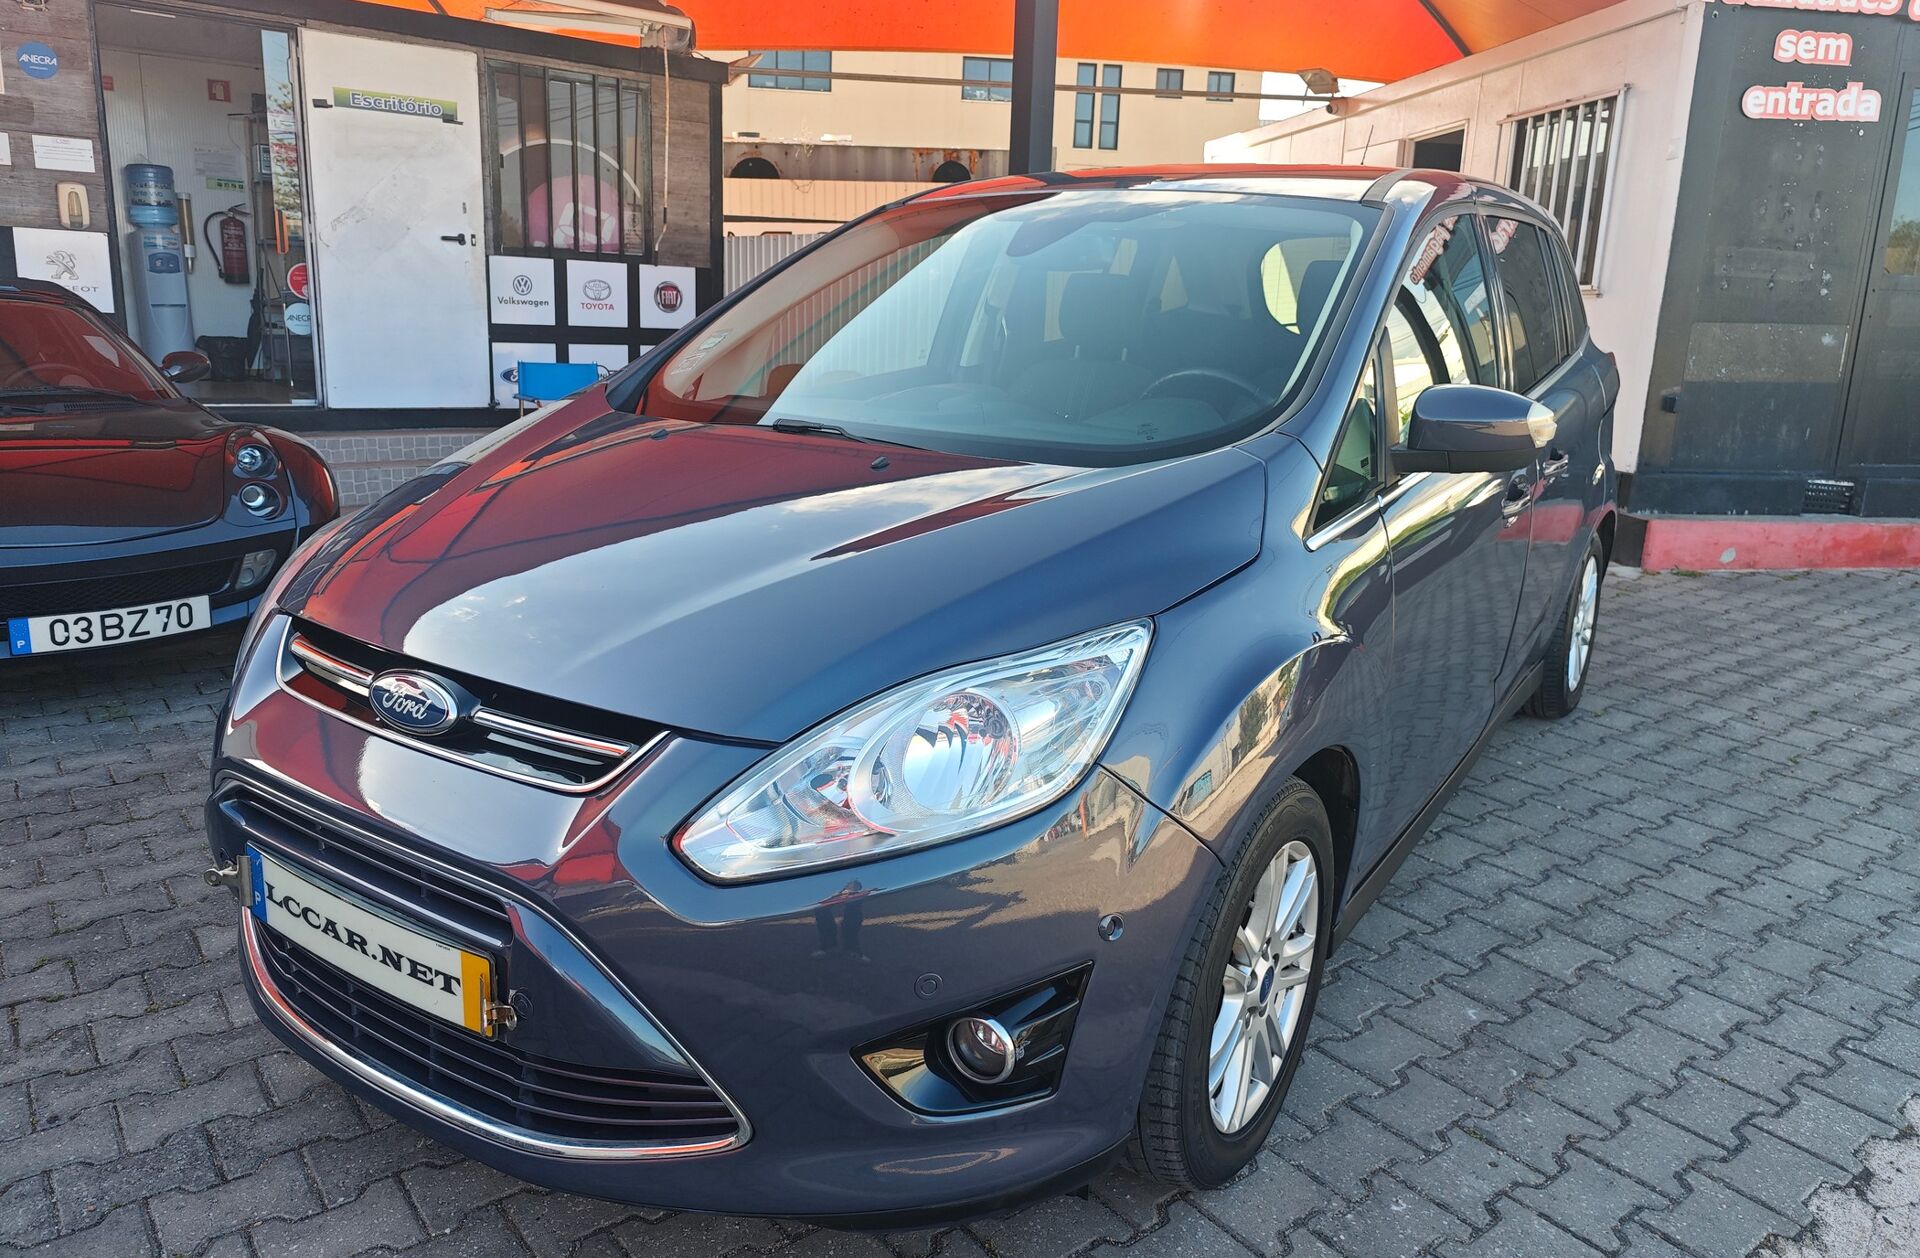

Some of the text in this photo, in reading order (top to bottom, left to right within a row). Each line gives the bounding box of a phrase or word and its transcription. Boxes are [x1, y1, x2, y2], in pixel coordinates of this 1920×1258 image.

[1778, 33, 1849, 61] sem
[19, 53, 57, 66] ANECRA
[350, 92, 443, 116] Escritório
[1745, 86, 1877, 118] entrada
[497, 296, 550, 308] Volkswagen
[661, 289, 677, 304] FIAT
[581, 302, 614, 311] TOYOTA
[286, 314, 311, 322] ANECR
[382, 681, 433, 720] Ford
[264, 881, 462, 997] LCCAR.NET
